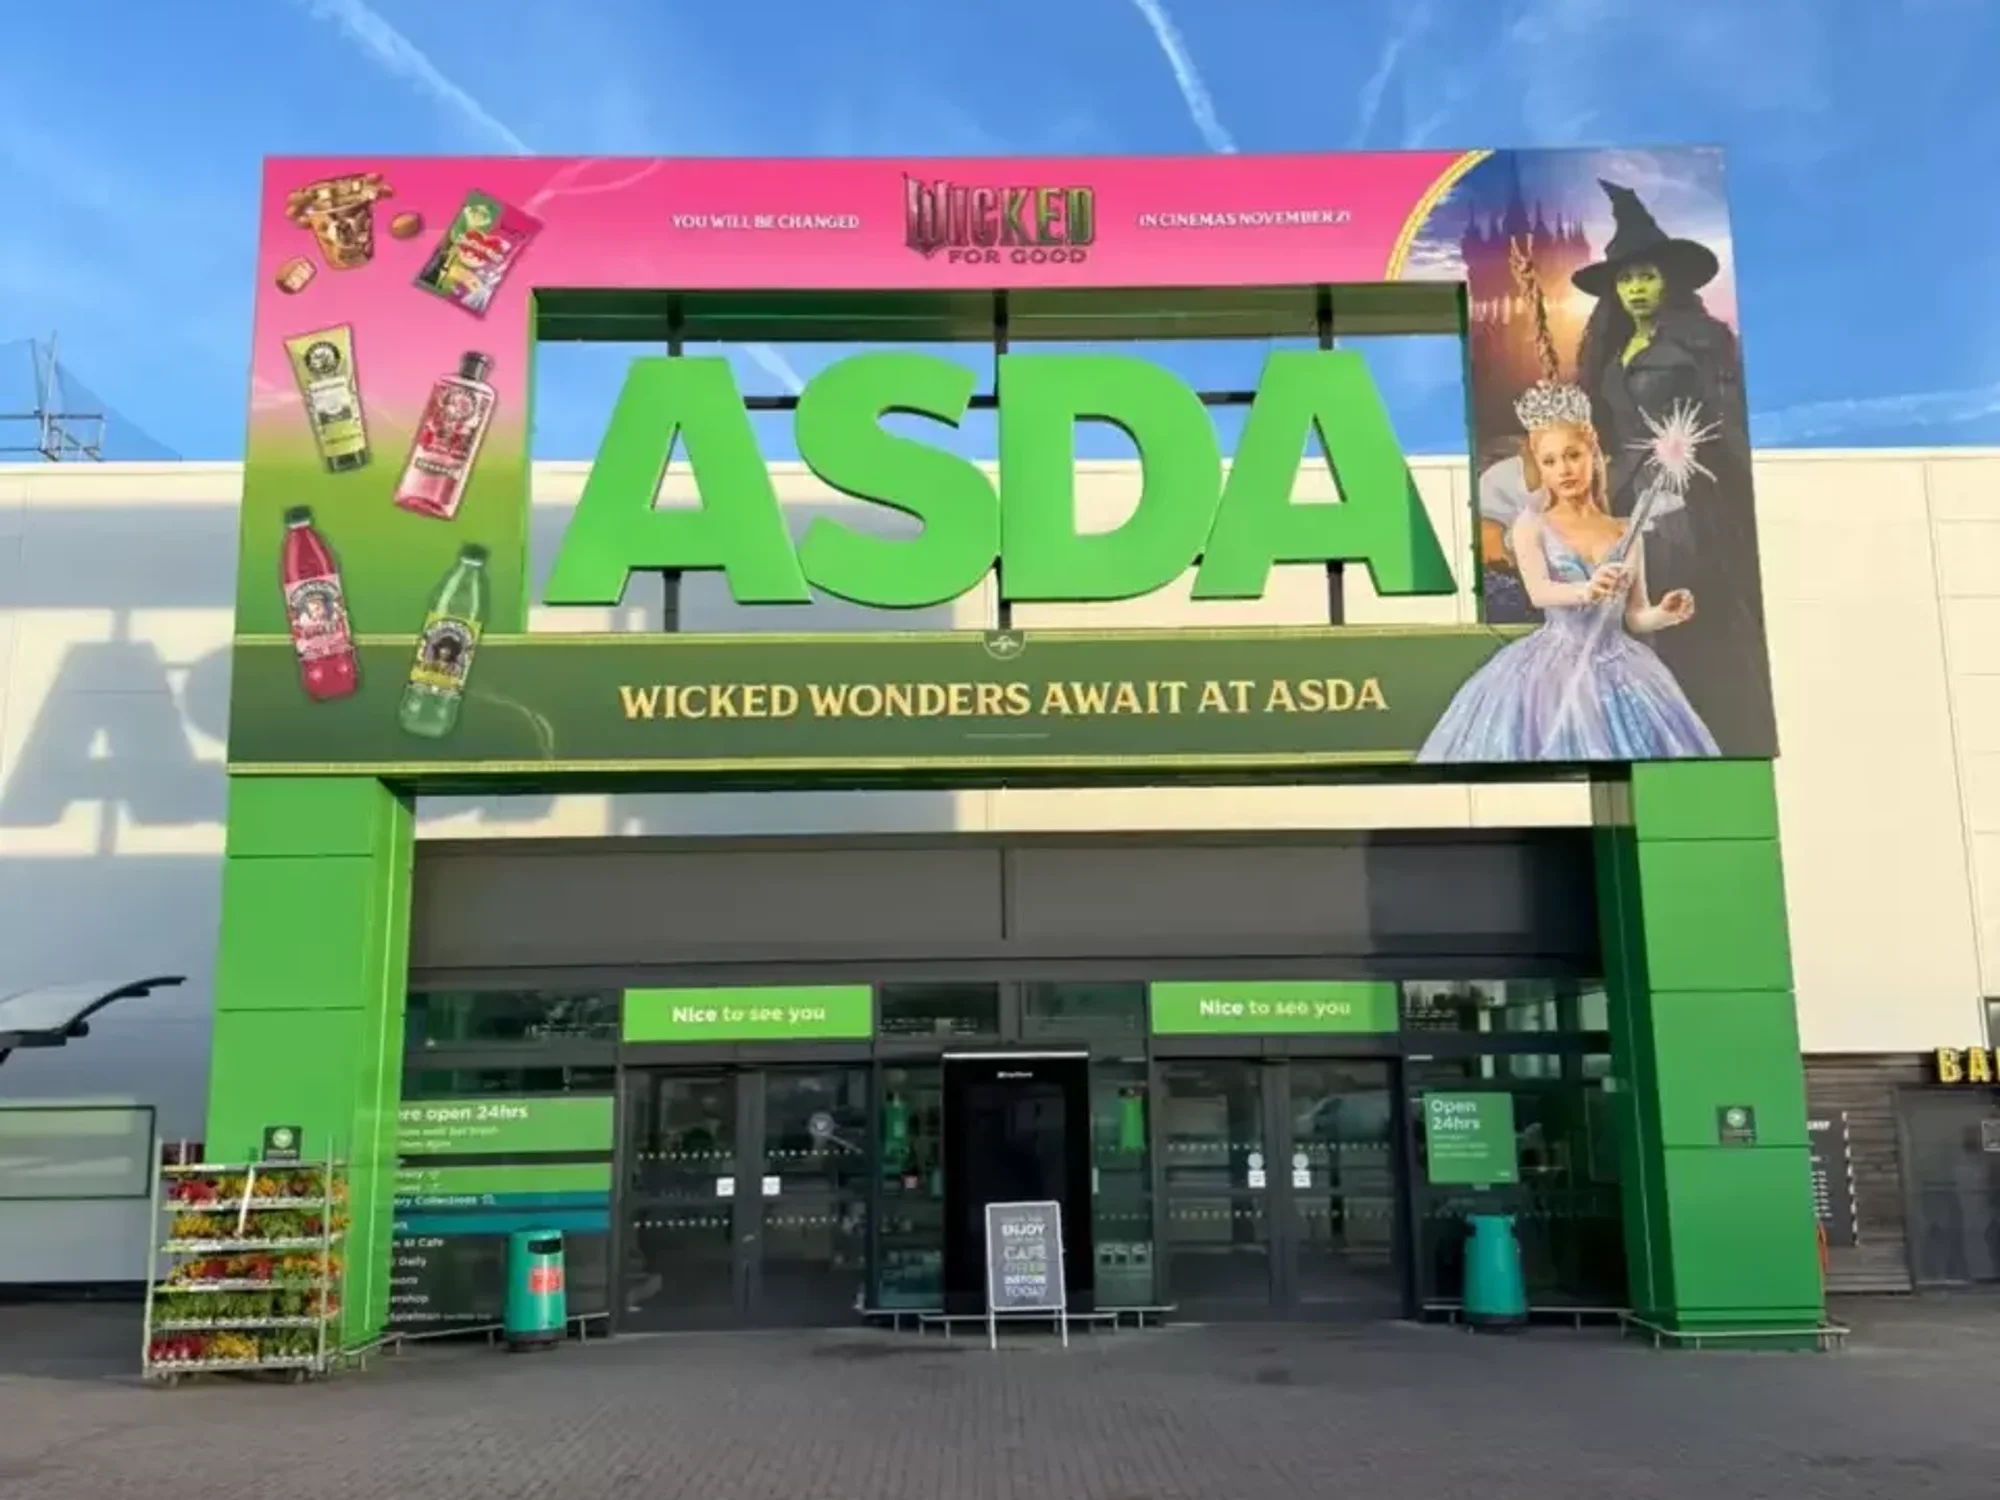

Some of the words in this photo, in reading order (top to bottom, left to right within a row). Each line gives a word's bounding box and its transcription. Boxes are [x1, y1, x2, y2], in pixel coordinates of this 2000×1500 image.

[672, 213, 707, 230] YOU
[709, 213, 750, 230] WILL
[754, 213, 775, 230] BE
[777, 213, 860, 231] CHANGED
[903, 172, 1097, 261] WICKED
[1138, 212, 1158, 228] IN
[1158, 211, 1236, 228] CINEMAS
[1238, 210, 1333, 226] NOVEMBER
[948, 248, 1000, 264] FOR
[1011, 248, 1088, 264] GOOD
[541, 349, 1458, 608] ASDA
[617, 683, 799, 719] WICKED
[805, 681, 1031, 718] WONDERS
[1040, 679, 1189, 716] AWAIT
[1197, 679, 1256, 714] AT
[1263, 676, 1391, 713] ASDA
[671, 1005, 718, 1023] Nice
[723, 1005, 745, 1022] to
[749, 1006, 783, 1021] see
[788, 1006, 826, 1026] you
[1199, 999, 1244, 1017] Nice
[1248, 999, 1270, 1015] to
[1275, 1000, 1310, 1015] see
[1315, 1002, 1352, 1019] you
[1938, 1045, 2000, 1083] BA
[426, 1106, 472, 1122] open
[476, 1104, 529, 1121] 24hrs
[1431, 1099, 1477, 1116] Open
[1432, 1116, 1480, 1131] 24hrs
[1001, 1222, 1047, 1237] ENJOY
